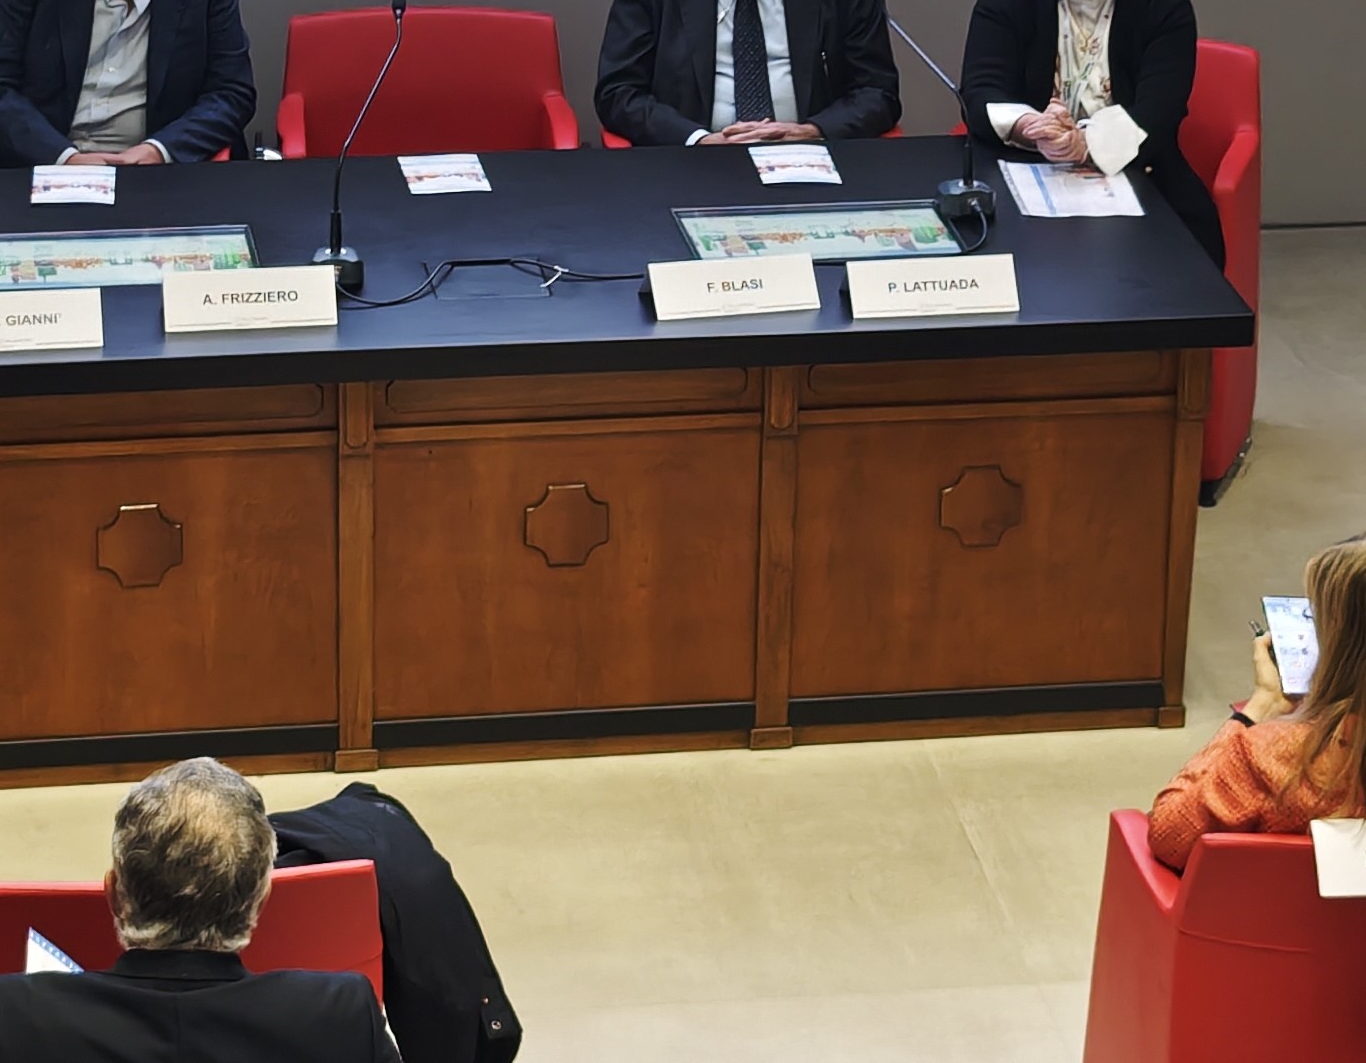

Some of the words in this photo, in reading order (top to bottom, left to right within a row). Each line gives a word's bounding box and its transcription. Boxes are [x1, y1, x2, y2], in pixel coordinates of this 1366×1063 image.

[706, 282, 720, 293] F.
[721, 278, 764, 292] BLASI
[887, 282, 901, 293] P.
[903, 278, 980, 293] LATTUADA
[202, 294, 218, 306] A.
[221, 290, 299, 305] FRIZZIERO
